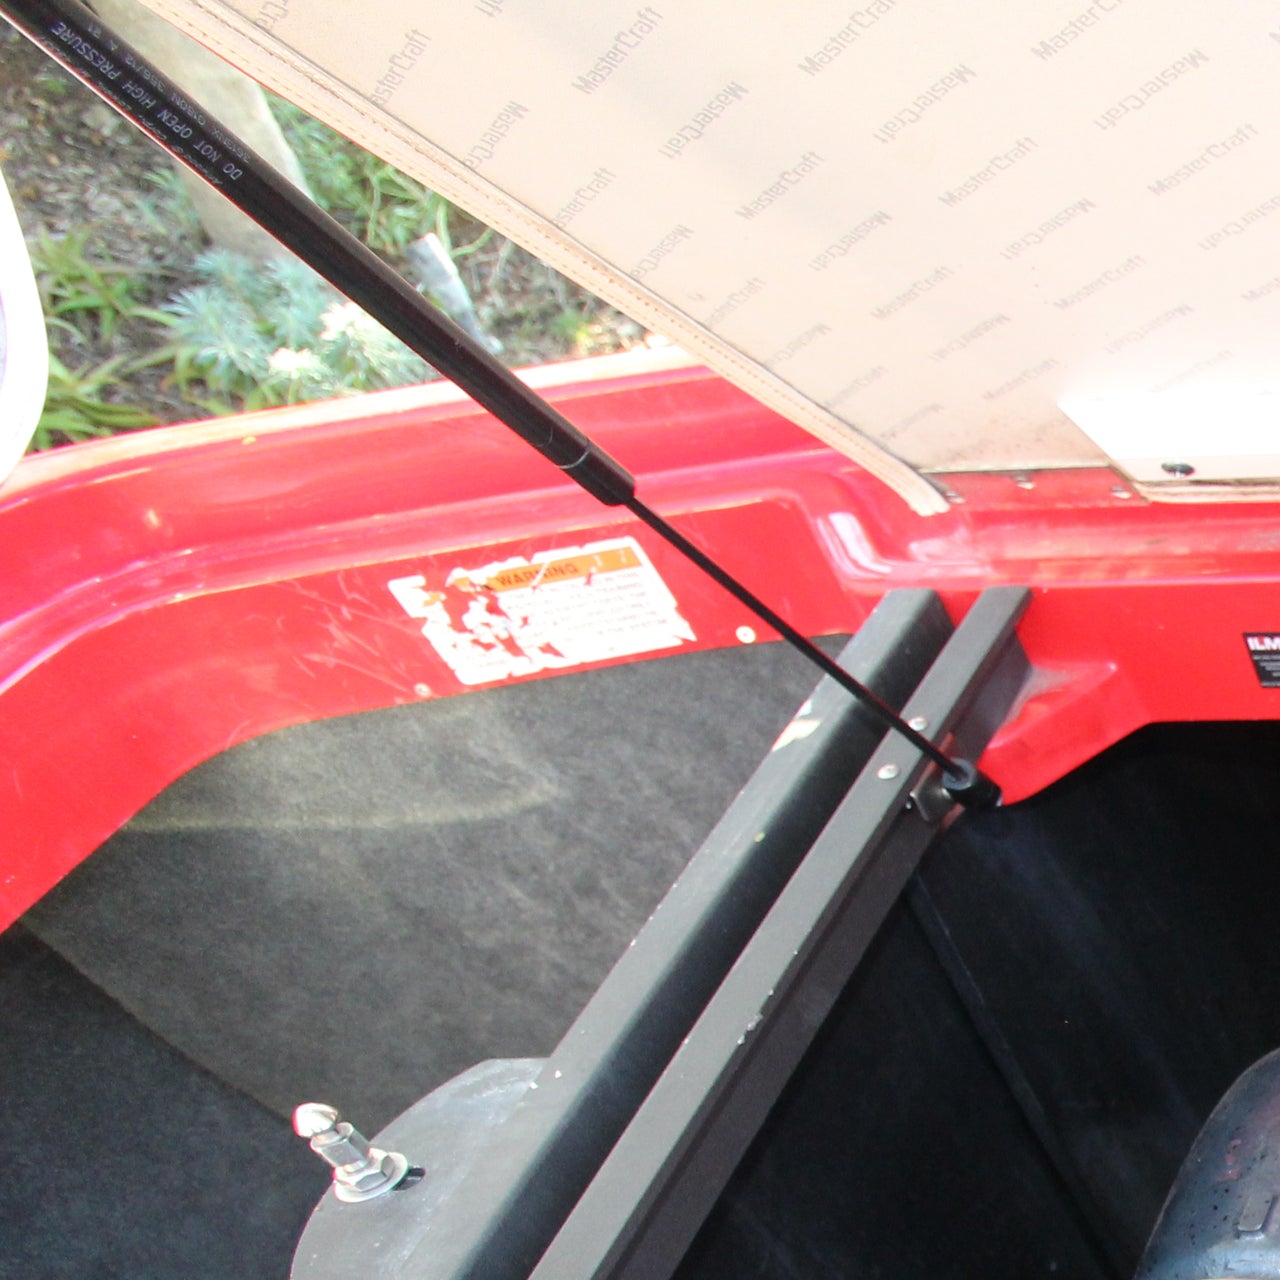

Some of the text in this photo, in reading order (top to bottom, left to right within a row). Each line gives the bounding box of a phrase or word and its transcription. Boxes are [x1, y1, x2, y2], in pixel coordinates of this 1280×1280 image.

[571, 6, 663, 95] MasterCraft
[51, 21, 243, 181] DO NOT OPEN HIGH PRESSURE
[658, 79, 749, 159] MasterCraft
[872, 63, 977, 144] MasterCraft
[1092, 47, 1210, 131] MasterCraft
[734, 150, 826, 220] MasterCraft
[937, 136, 1039, 207] MasterCraft
[1146, 123, 1259, 196] MasterCraft
[808, 210, 893, 271] MasterCraft
[999, 197, 1097, 260] MasterCraft
